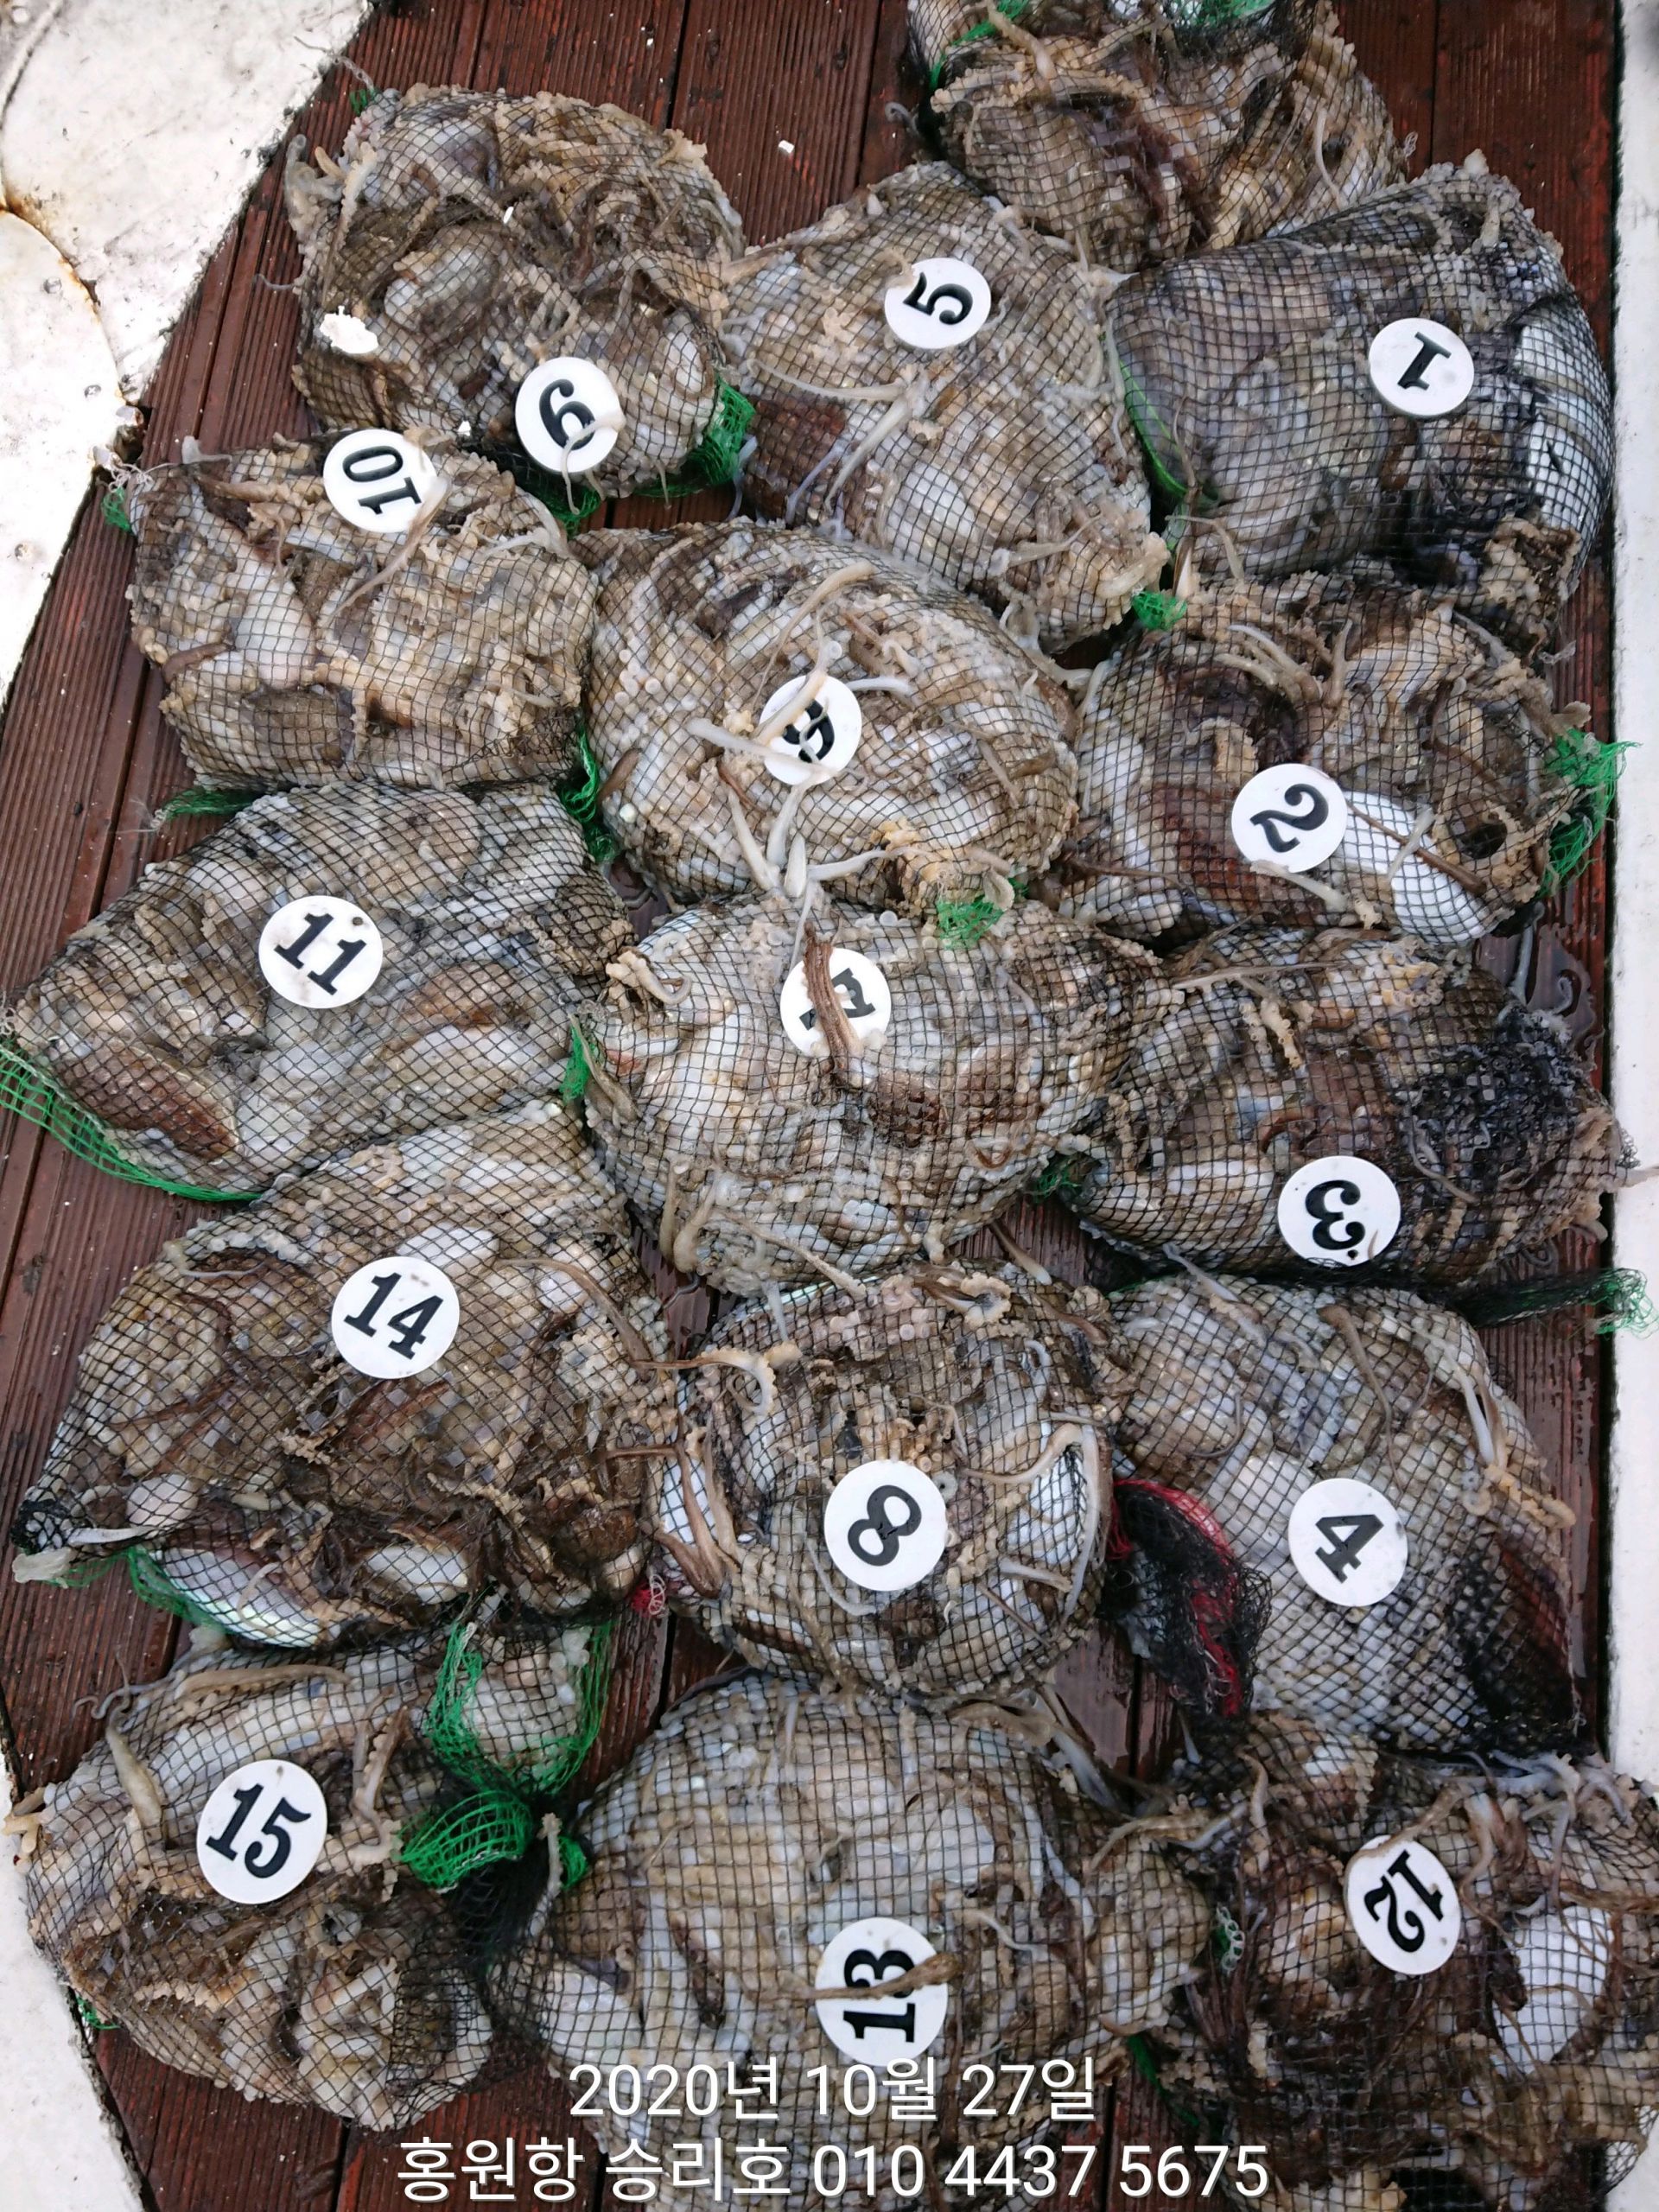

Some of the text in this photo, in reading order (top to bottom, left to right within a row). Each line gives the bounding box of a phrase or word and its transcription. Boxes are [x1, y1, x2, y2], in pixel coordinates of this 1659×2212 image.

[904, 272, 972, 326] 5
[1397, 333, 1451, 391] 1
[344, 448, 422, 515] 10
[1249, 783, 1328, 853] 2
[275, 914, 365, 995] 11
[1305, 1179, 1365, 1250] 3
[345, 1274, 442, 1359] 14
[849, 1484, 922, 1566] 8
[1315, 1514, 1383, 1583] 4
[207, 1784, 310, 1878] 15
[1364, 1850, 1444, 1953] 12
[842, 1948, 918, 2044] 13
